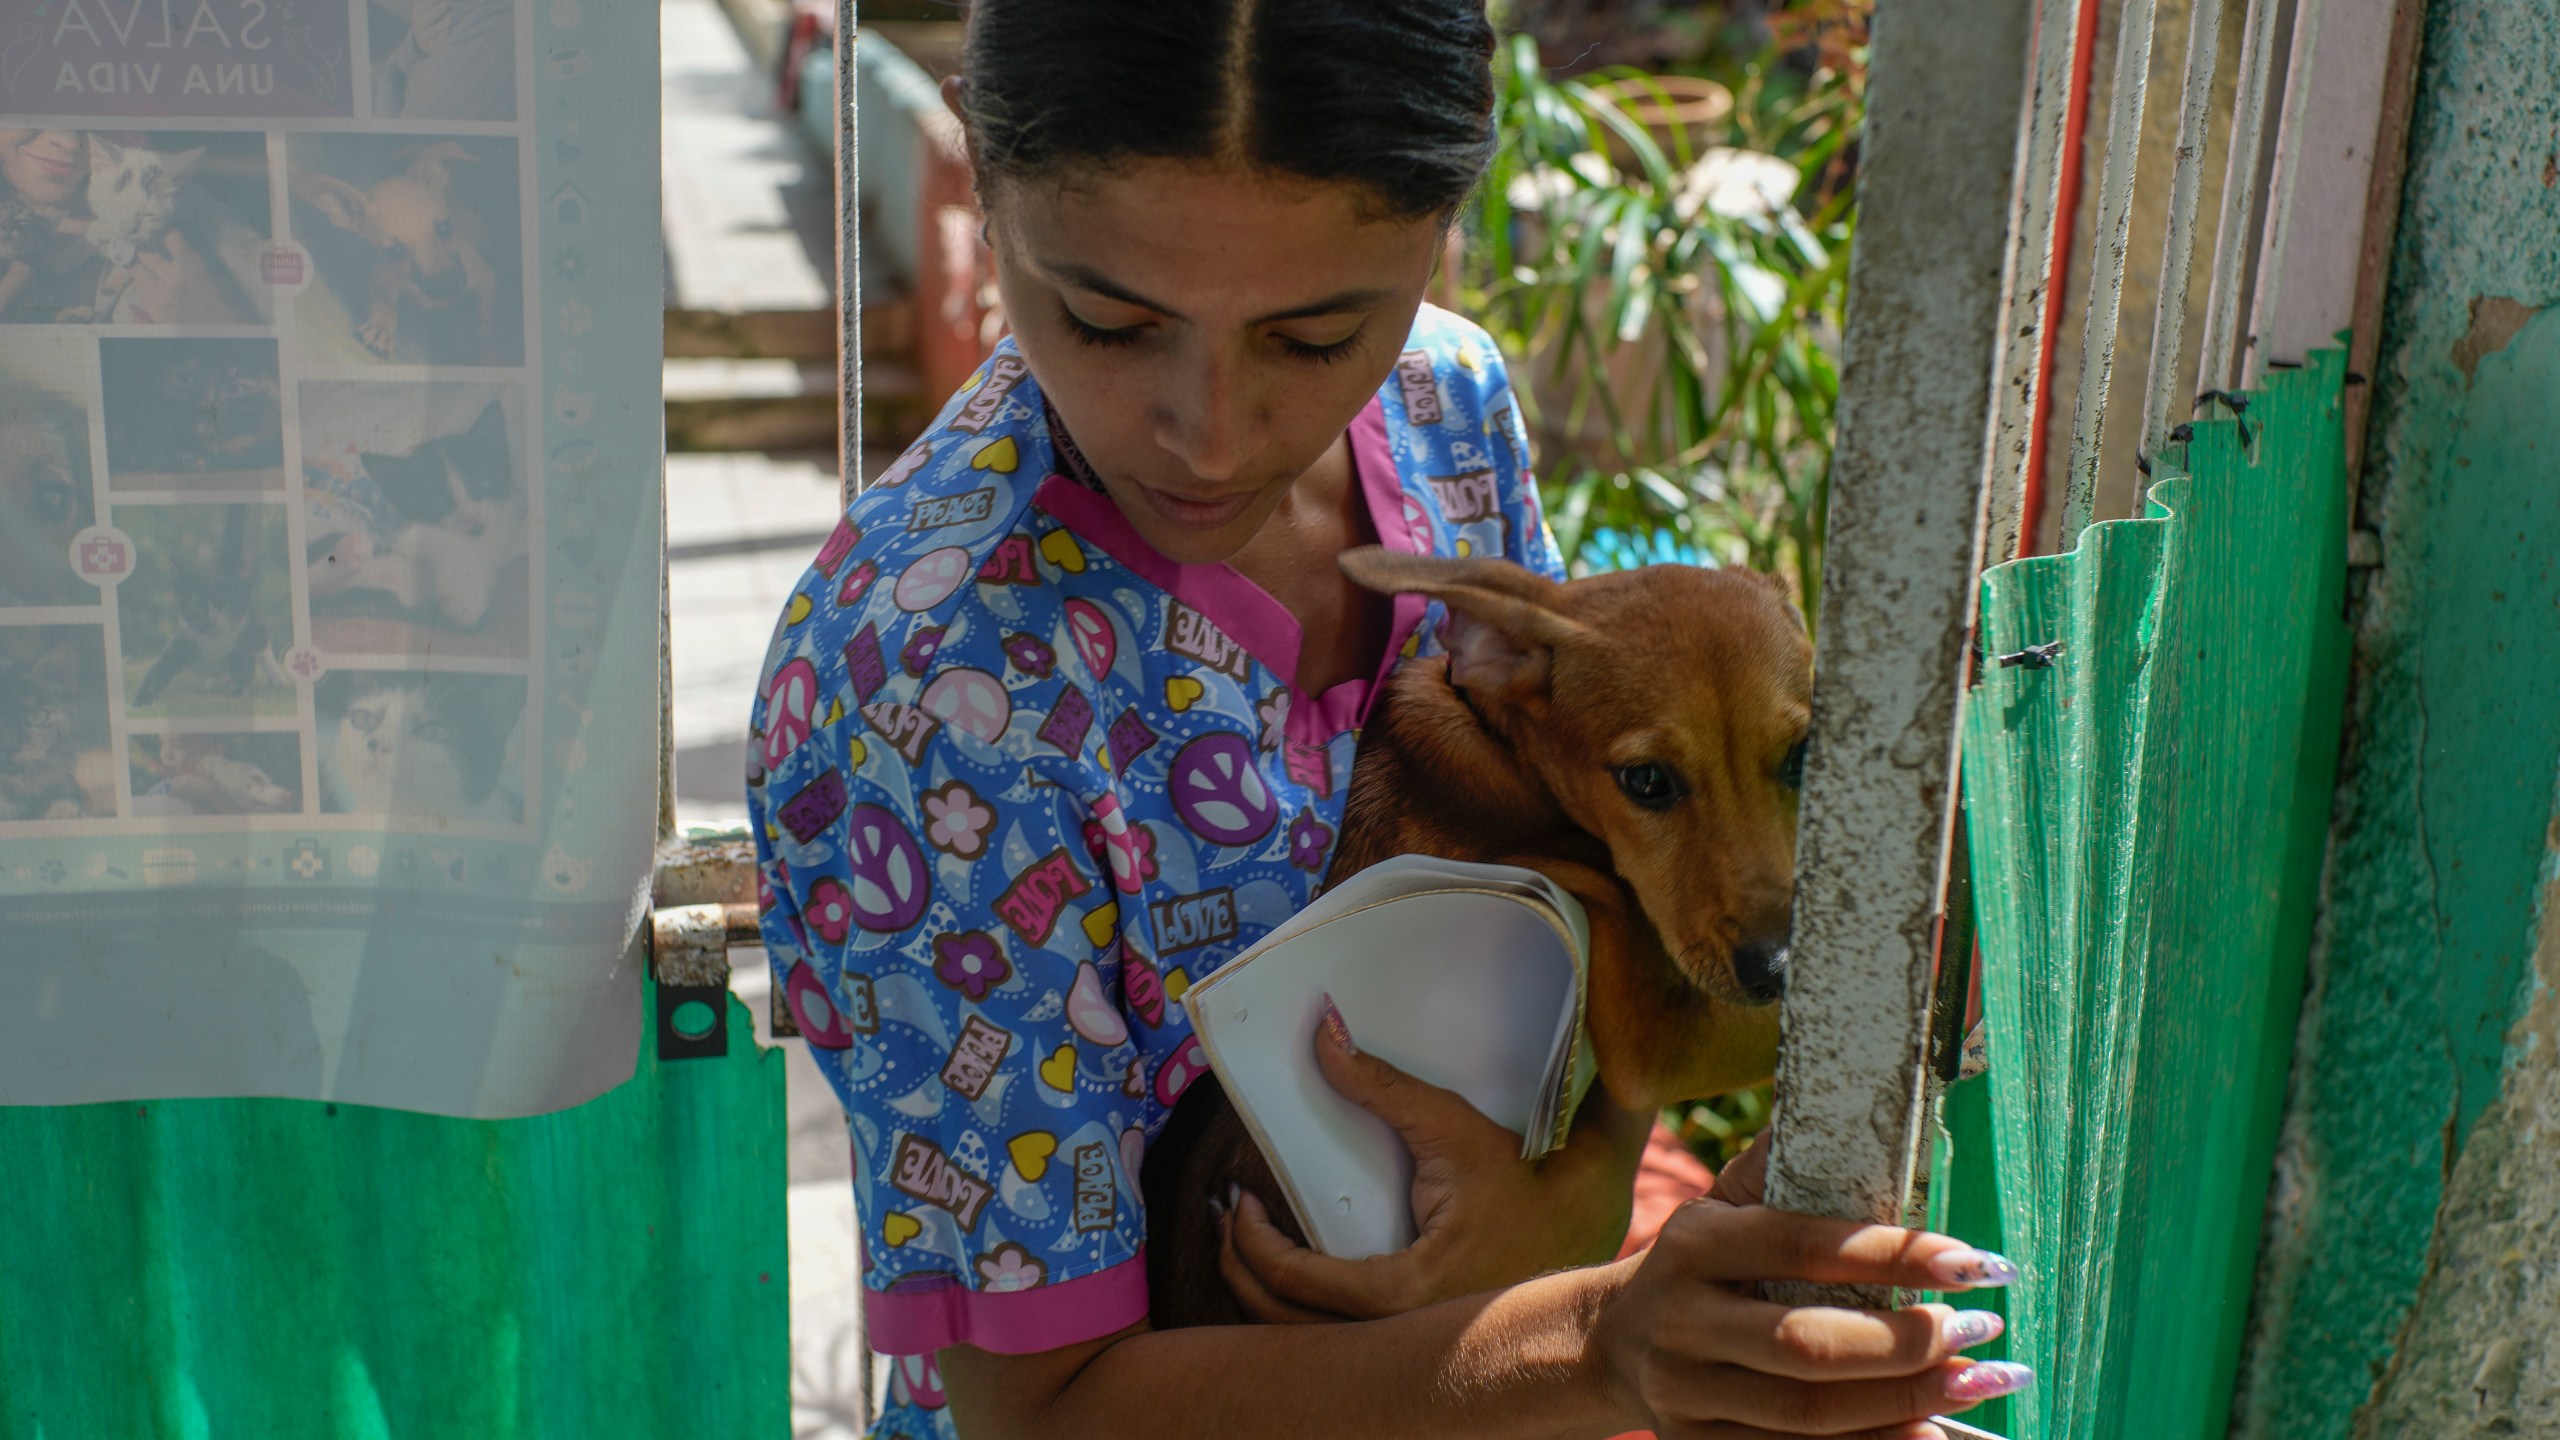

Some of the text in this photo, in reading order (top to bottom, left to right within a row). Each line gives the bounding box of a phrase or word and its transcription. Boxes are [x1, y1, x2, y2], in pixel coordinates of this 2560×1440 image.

[953, 357, 1026, 433] LOVE
[1400, 354, 1440, 422] PEACE
[913, 490, 992, 529] PEACE
[1003, 855, 1082, 939] LOVE
[1154, 894, 1232, 949] LOVE
[947, 1021, 1008, 1097] PEACE
[896, 1140, 989, 1227] LOVE
[1077, 1147, 1113, 1229] PEACE
